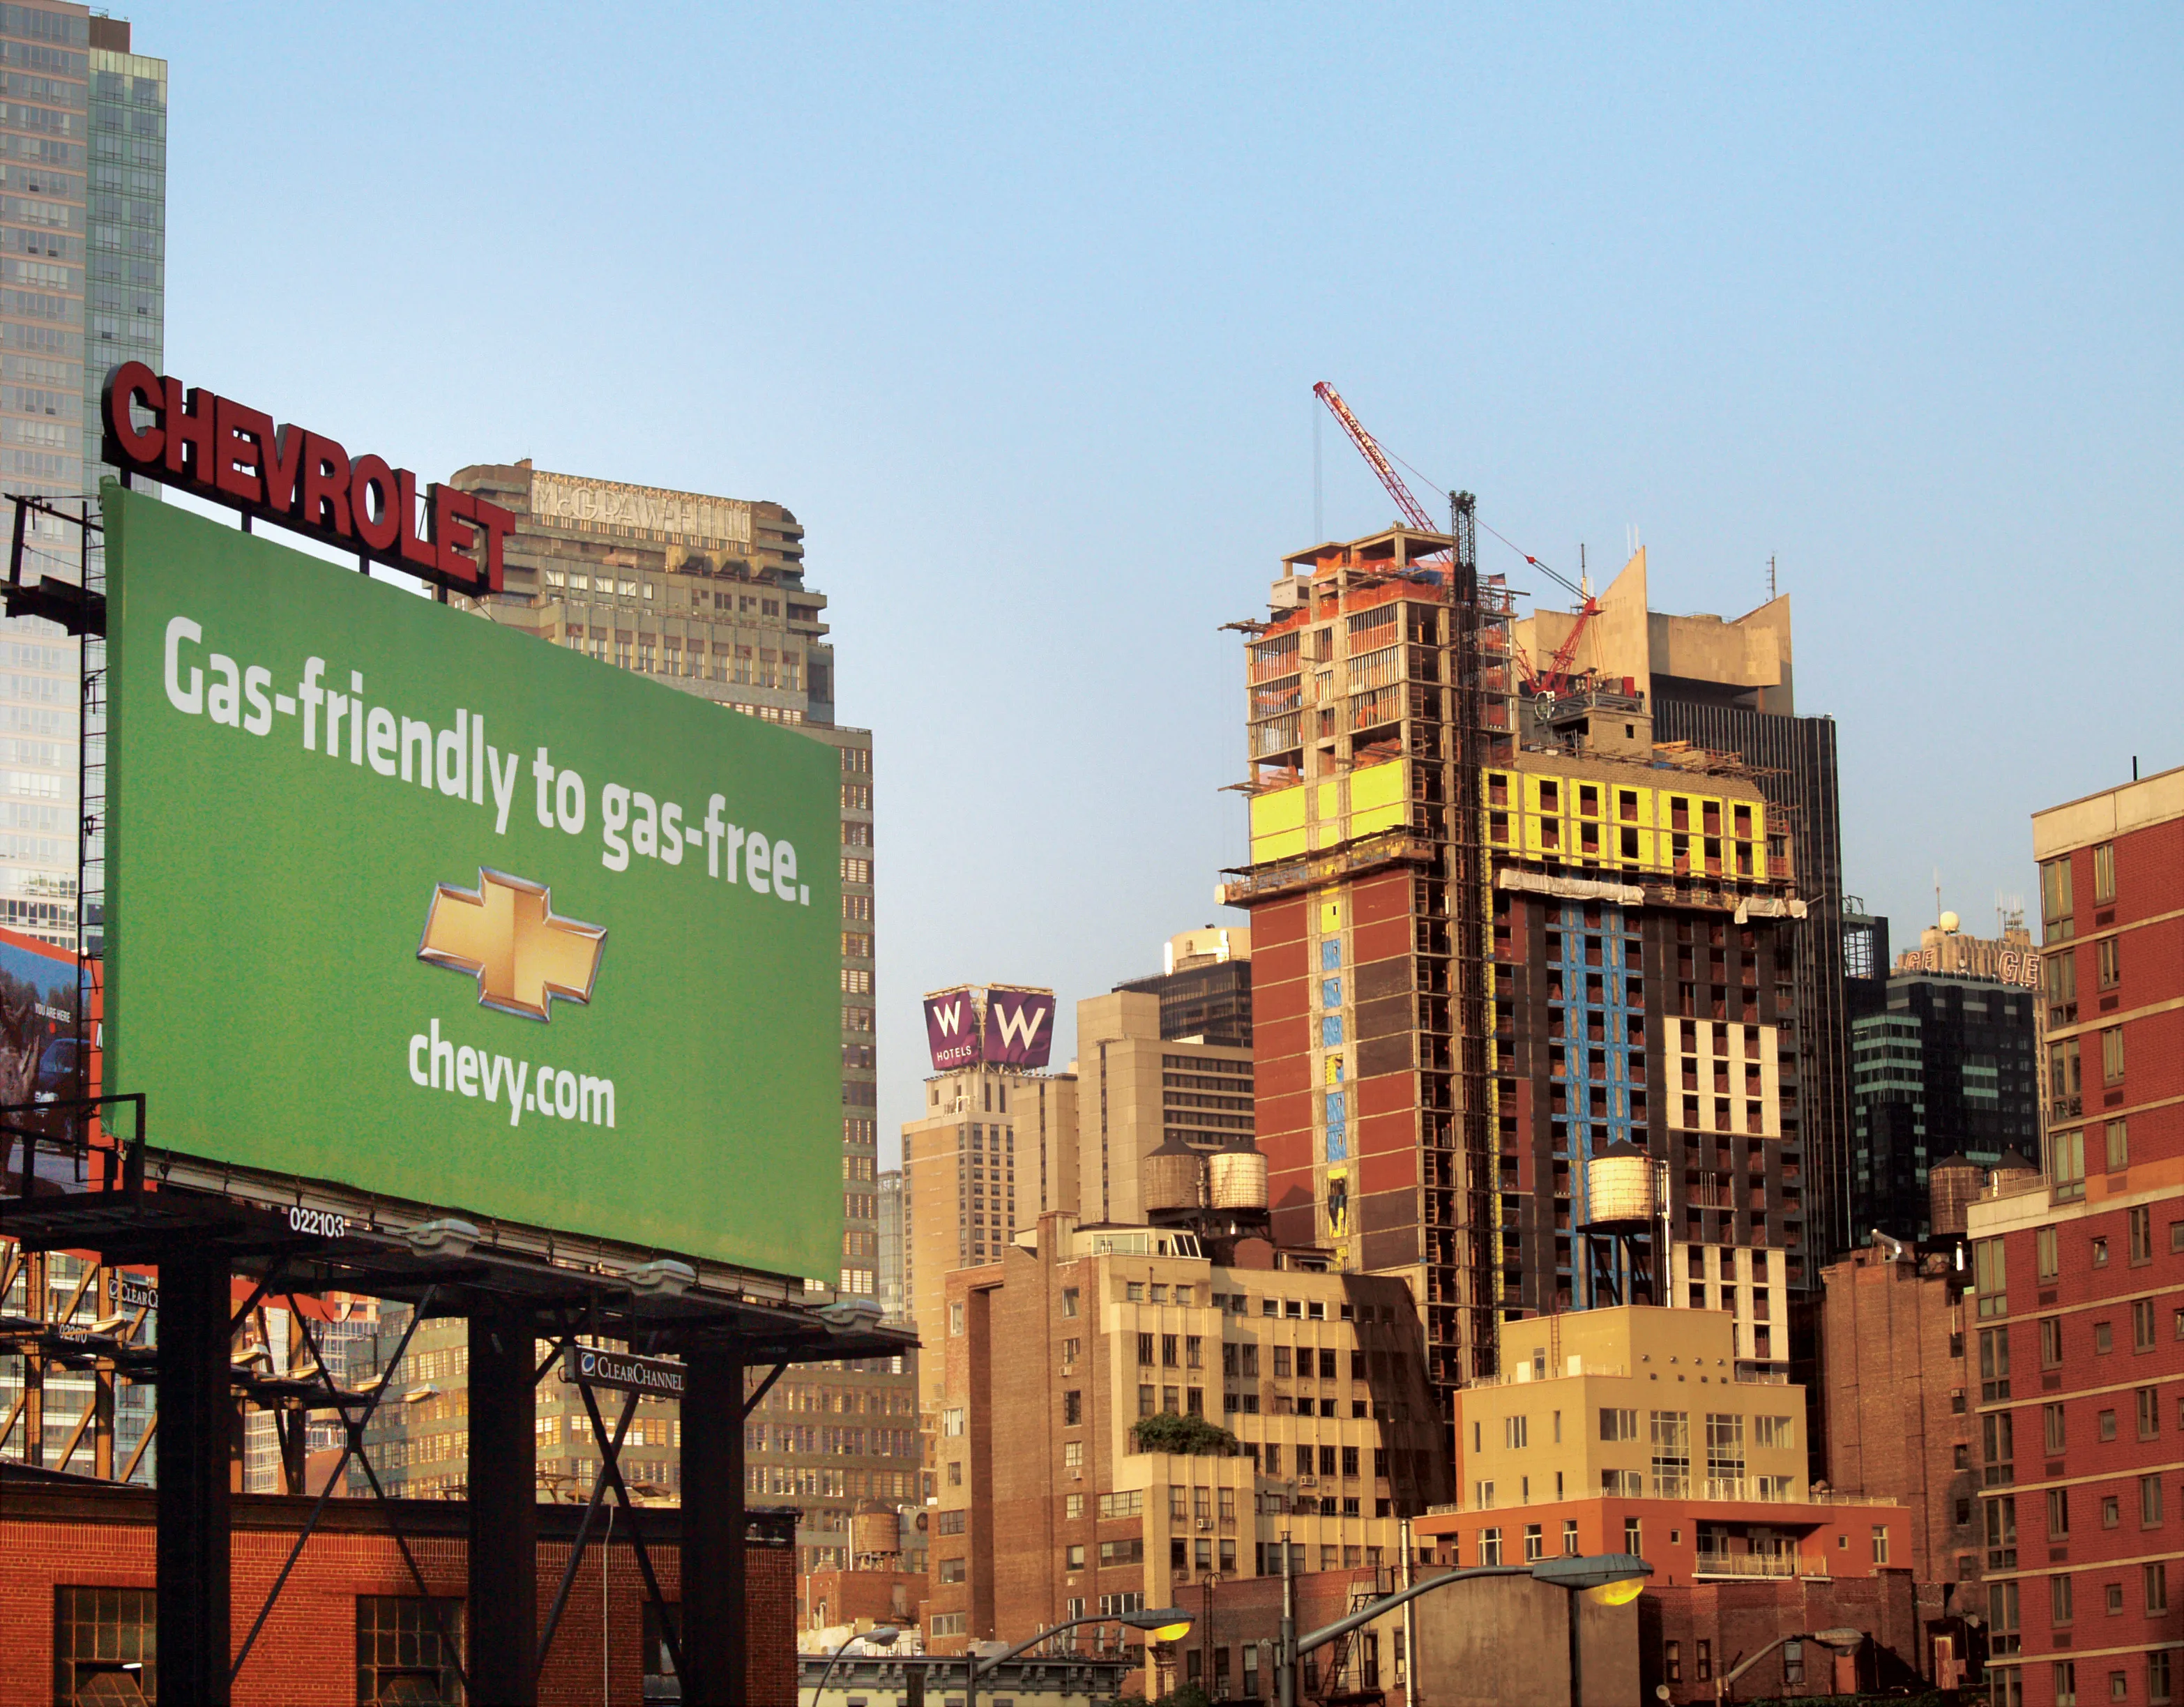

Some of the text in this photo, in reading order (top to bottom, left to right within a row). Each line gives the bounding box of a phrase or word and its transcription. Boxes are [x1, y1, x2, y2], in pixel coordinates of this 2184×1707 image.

[103, 361, 515, 593] CHEVROLET
[165, 616, 810, 906] Gas-friendly to gas-free.
[1906, 949, 1934, 970] GE
[1999, 951, 2040, 984] GE
[35, 1002, 70, 1023] YOU ARE HERE
[933, 1001, 961, 1038] W
[994, 1003, 1046, 1051] W
[936, 1045, 972, 1061] HOTELS
[409, 1018, 615, 1128] chevy.com
[290, 1206, 345, 1238] 022103
